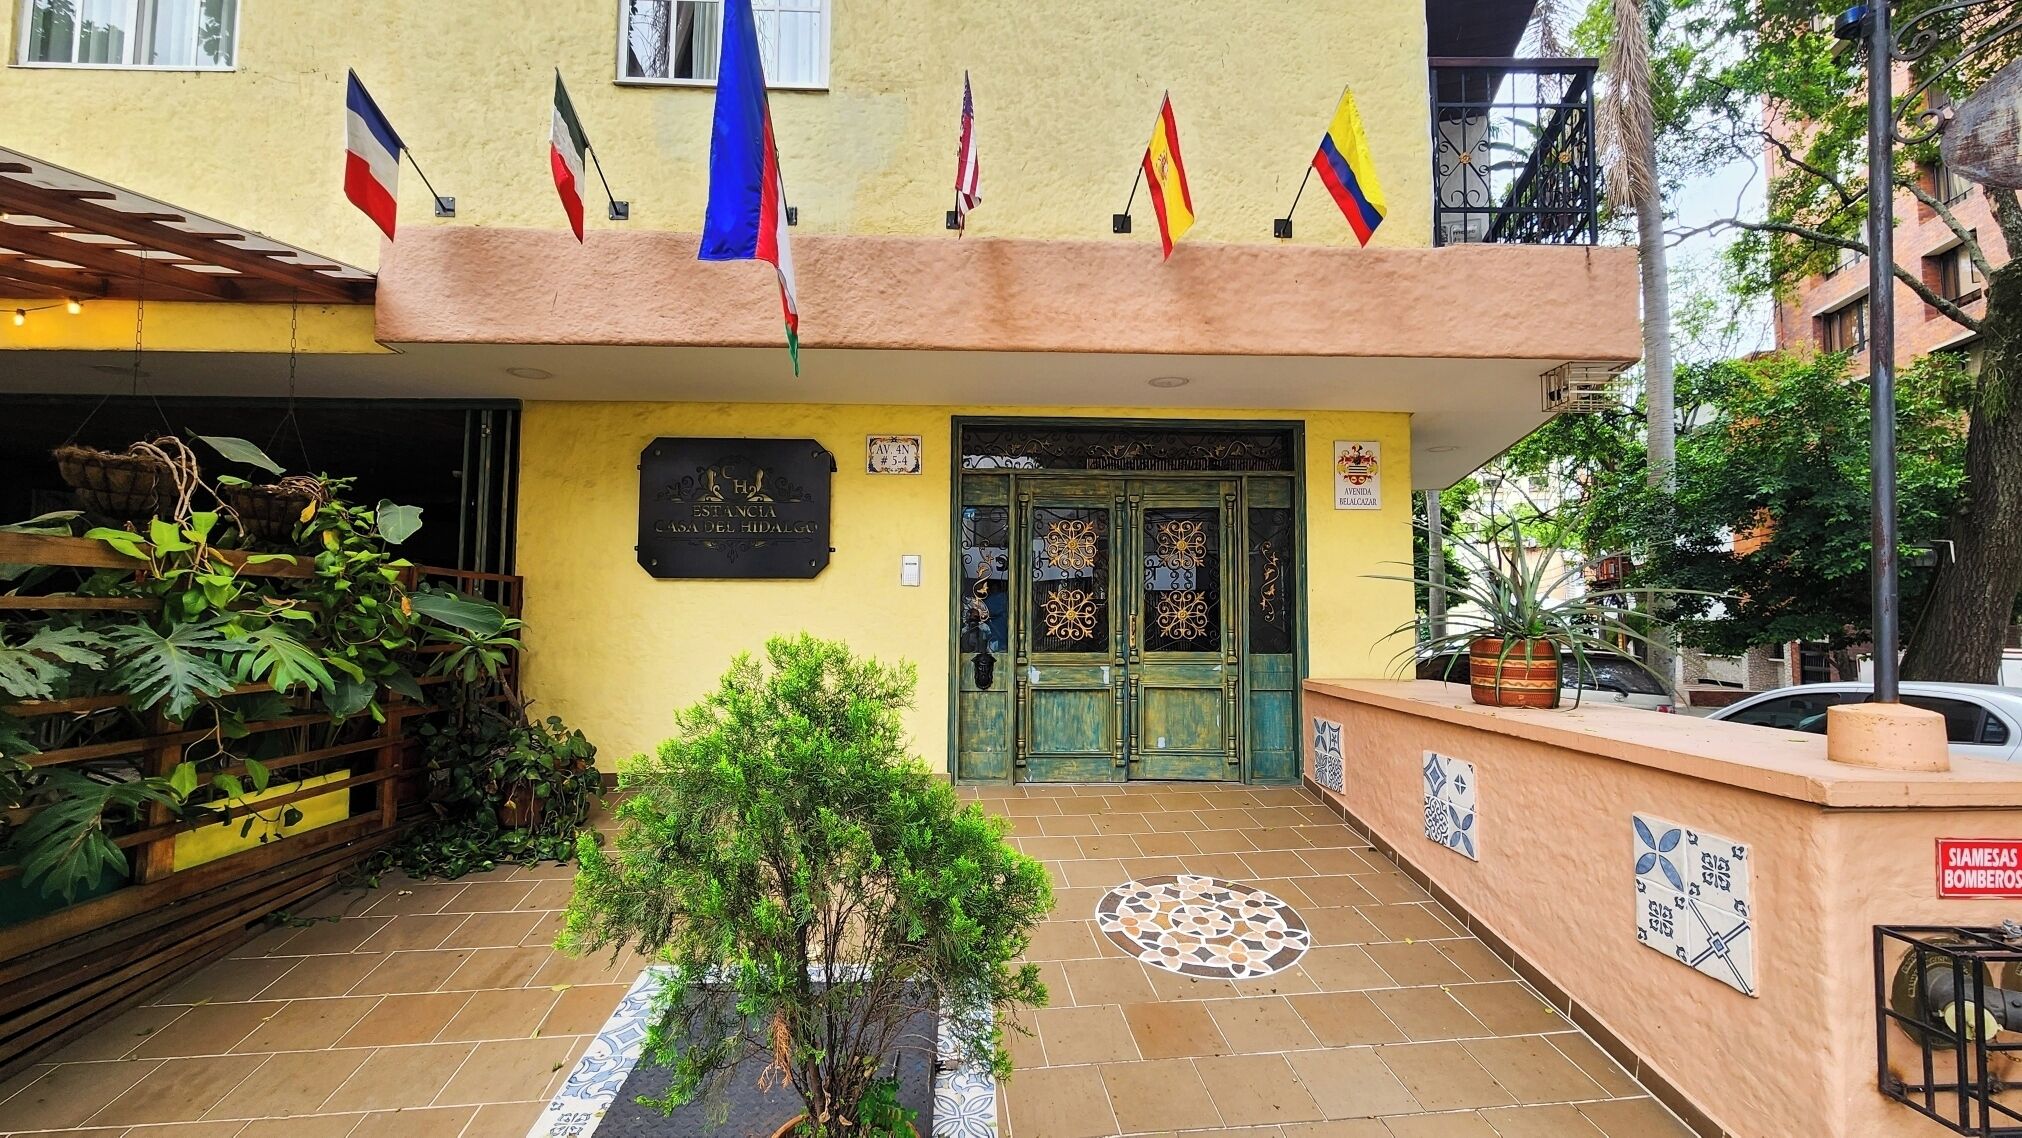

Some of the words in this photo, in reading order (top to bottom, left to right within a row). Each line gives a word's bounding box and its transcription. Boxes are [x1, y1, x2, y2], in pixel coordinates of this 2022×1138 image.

[876, 444, 893, 454] AV.
[896, 444, 910, 454] 4N
[880, 455, 888, 466] #
[892, 455, 908, 466] 5-4
[733, 479, 748, 494] H
[1344, 487, 1372, 496] AVENIDA
[1339, 497, 1377, 506] BELALCAZAR
[693, 505, 777, 518] ESTANCIA
[654, 519, 700, 533] CASA
[704, 519, 735, 533] DEL
[741, 520, 818, 534] HIDALGO
[1948, 847, 2018, 868] SIAMESAS
[1944, 869, 2022, 889] BOMBEROS
